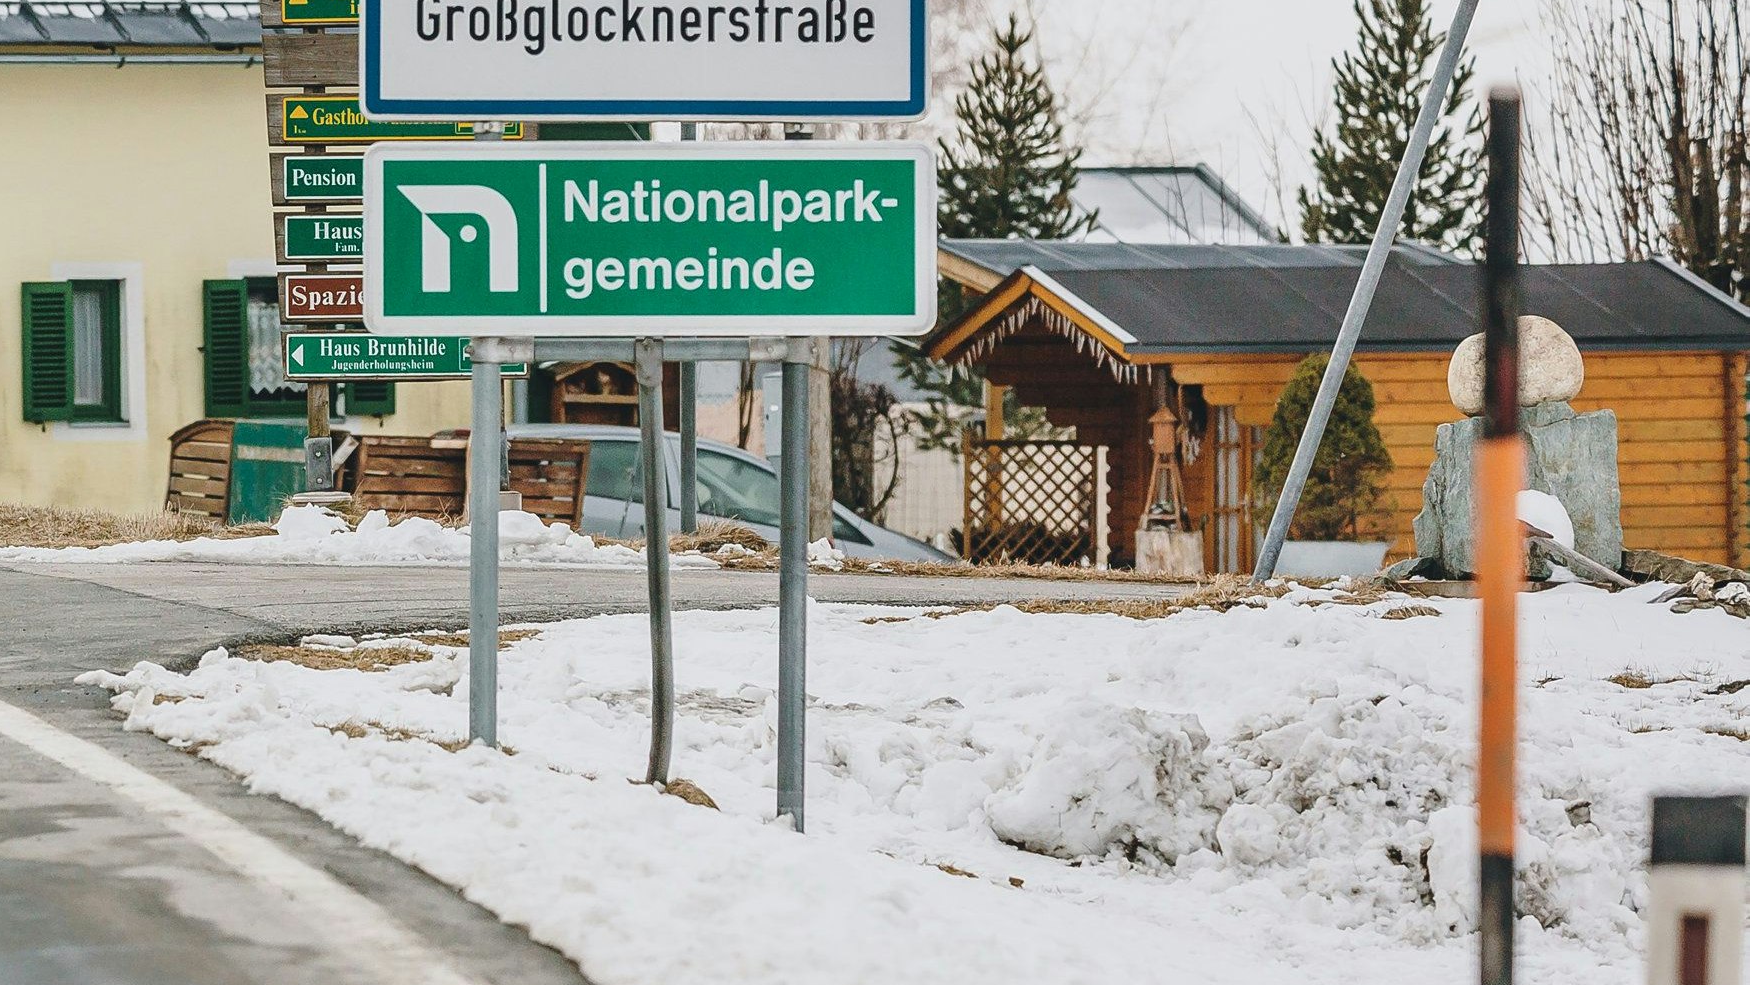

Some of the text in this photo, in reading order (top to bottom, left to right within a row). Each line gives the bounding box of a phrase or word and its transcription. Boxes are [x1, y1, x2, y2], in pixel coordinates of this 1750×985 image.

[292, 167, 357, 187] Pension
[564, 179, 898, 232] Nationalpark-
[313, 221, 363, 240] Haus
[563, 246, 815, 300] gemeinde
[319, 338, 447, 357] Haus Brunhilde
[331, 359, 435, 371] Jugenderholungsheim
